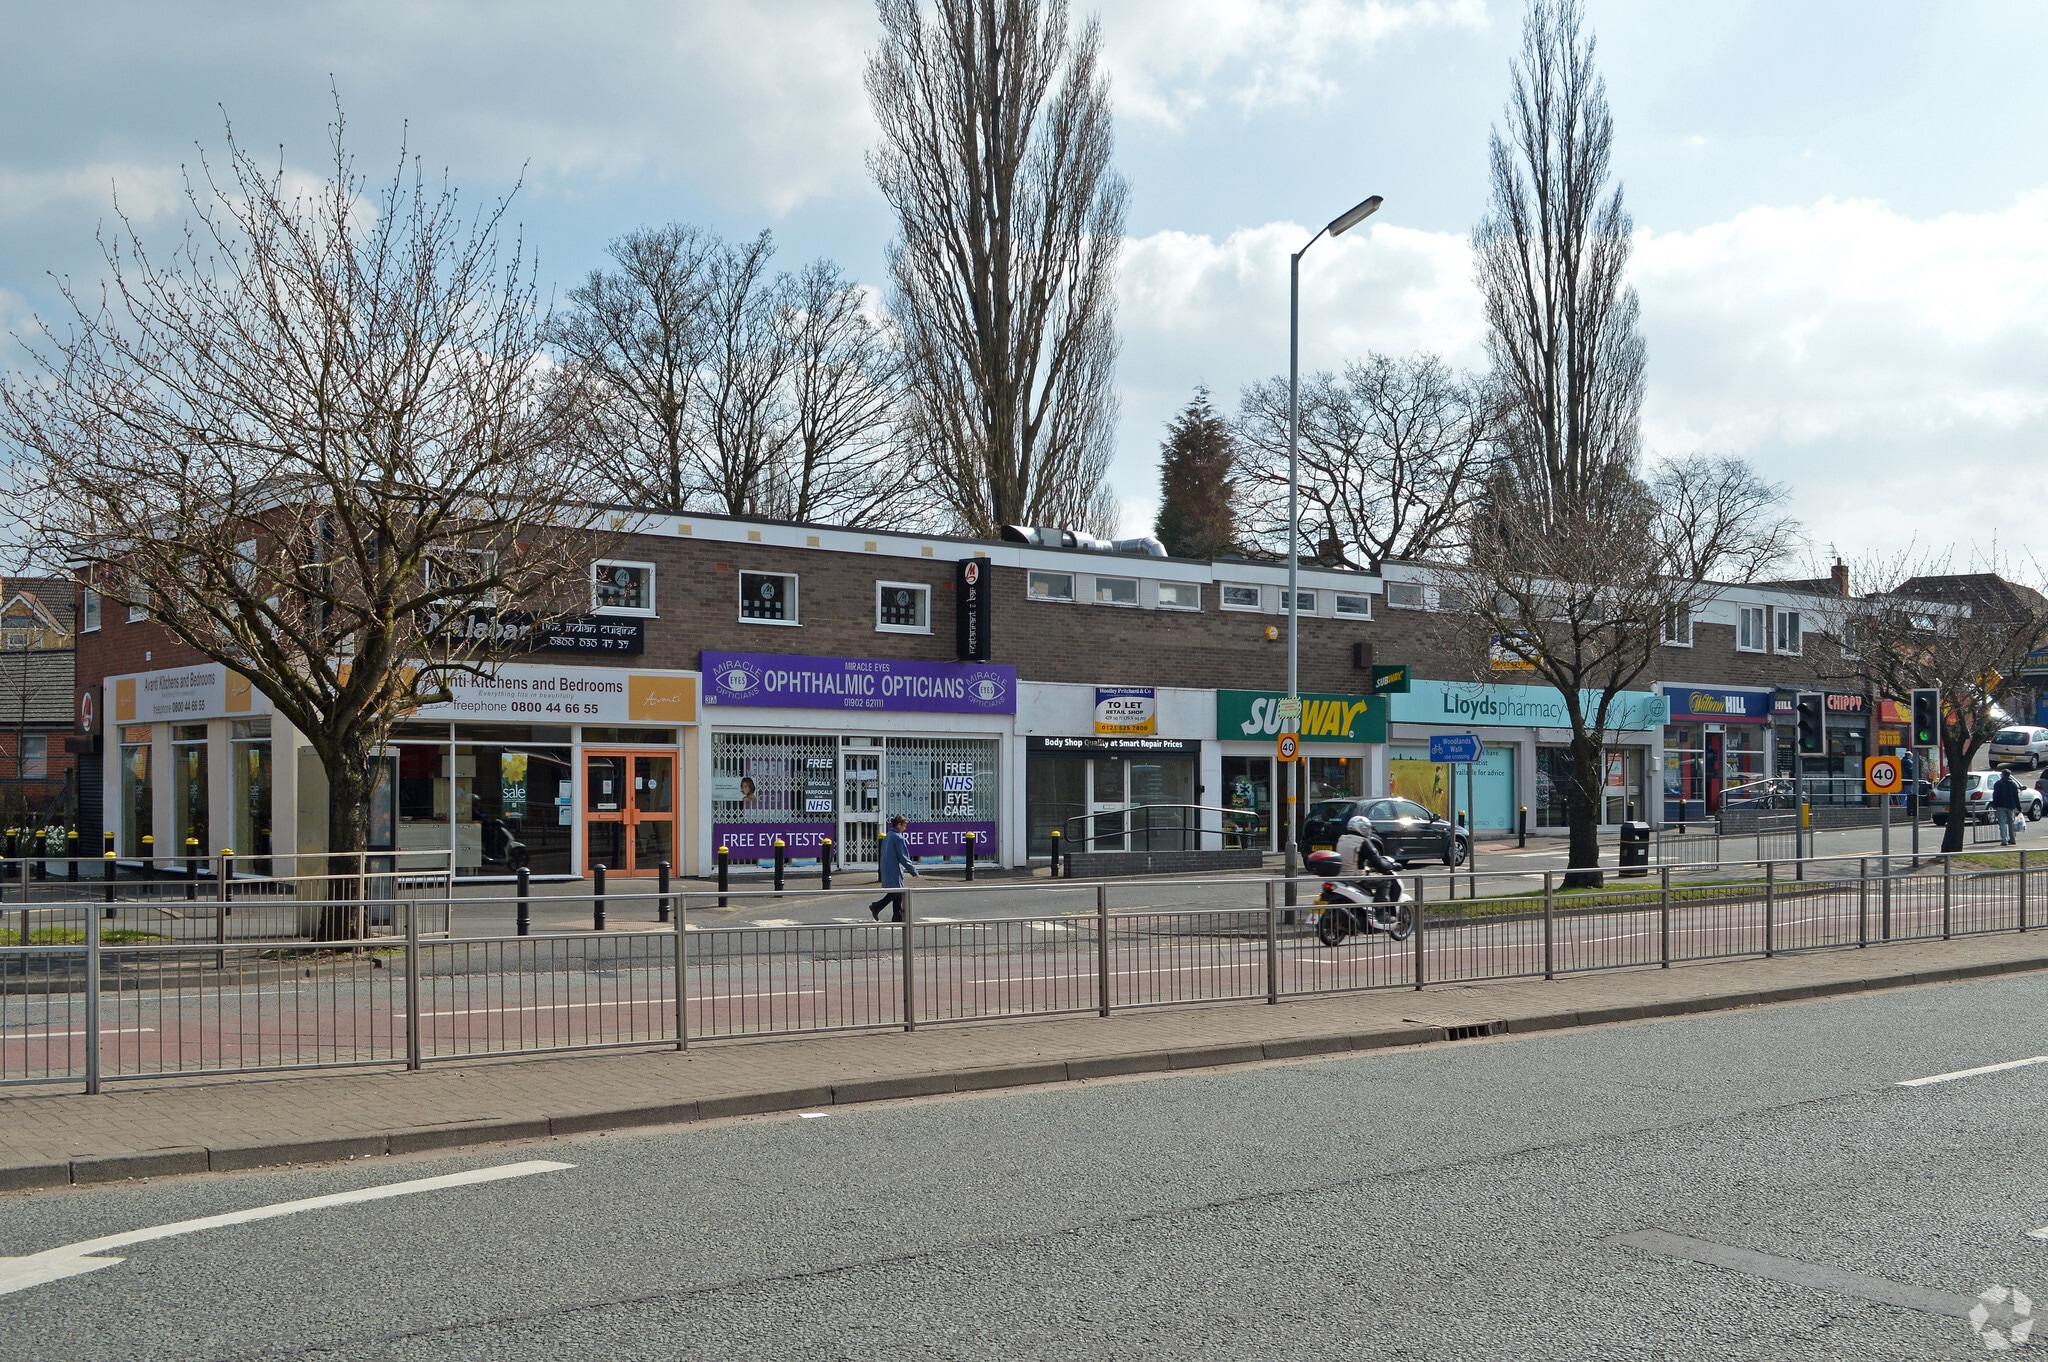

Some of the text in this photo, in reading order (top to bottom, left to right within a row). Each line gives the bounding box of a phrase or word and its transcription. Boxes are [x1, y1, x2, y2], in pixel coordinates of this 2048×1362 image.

[565, 618, 596, 633] indian
[601, 622, 637, 636] cuisine
[549, 636, 575, 647] 0800
[579, 637, 598, 648] 030
[713, 659, 762, 678] MIRACLE
[844, 661, 890, 672] MIRACLE EYES
[144, 672, 215, 692] Avanti Kitchens and Bedrooms
[471, 674, 528, 690] Kitchens
[532, 677, 556, 691] and
[560, 677, 623, 693] Bedrooms
[730, 676, 746, 685] EYES
[764, 669, 965, 698] OPHTHALMIC OPTICIANS
[965, 671, 1008, 688] MIRACLE
[1375, 670, 1404, 688] SUBWAY
[478, 690, 515, 698] Everything
[716, 686, 760, 700] OPTICIANS
[980, 686, 993, 694] EYES
[172, 701, 183, 713] 0800
[184, 701, 190, 711] 44
[191, 700, 198, 711] 66
[198, 700, 205, 711] 55
[453, 700, 599, 714] freephone 0800 44 66 55
[844, 698, 884, 708] 01902 621111
[968, 695, 1006, 708] OPTICIANS
[1107, 701, 1142, 709] TO LET
[1444, 693, 1564, 723] Lloydspharmacy
[1689, 691, 1746, 713] William HILL
[1775, 700, 1793, 710] HILL
[1827, 694, 1862, 711] CHIPPY
[1045, 738, 1063, 748] Body
[1064, 739, 1083, 748] Shop
[1084, 739, 1109, 749] Quality
[1119, 739, 1140, 747] Smart
[1141, 740, 1162, 749] Repair
[1163, 740, 1183, 748] Prices
[1283, 743, 1294, 752] 40
[806, 758, 833, 768] FREE
[945, 763, 973, 774] FREE
[1488, 769, 1505, 777] advice
[1874, 768, 1893, 780] 40
[944, 777, 973, 790] NHS
[502, 784, 526, 798] sale
[948, 793, 972, 804] EYE-
[807, 800, 830, 811] NHS
[944, 805, 974, 816] CARE
[722, 833, 754, 847] FREE
[786, 832, 825, 846] TESTS
[903, 831, 987, 845] REE EYE TETS
